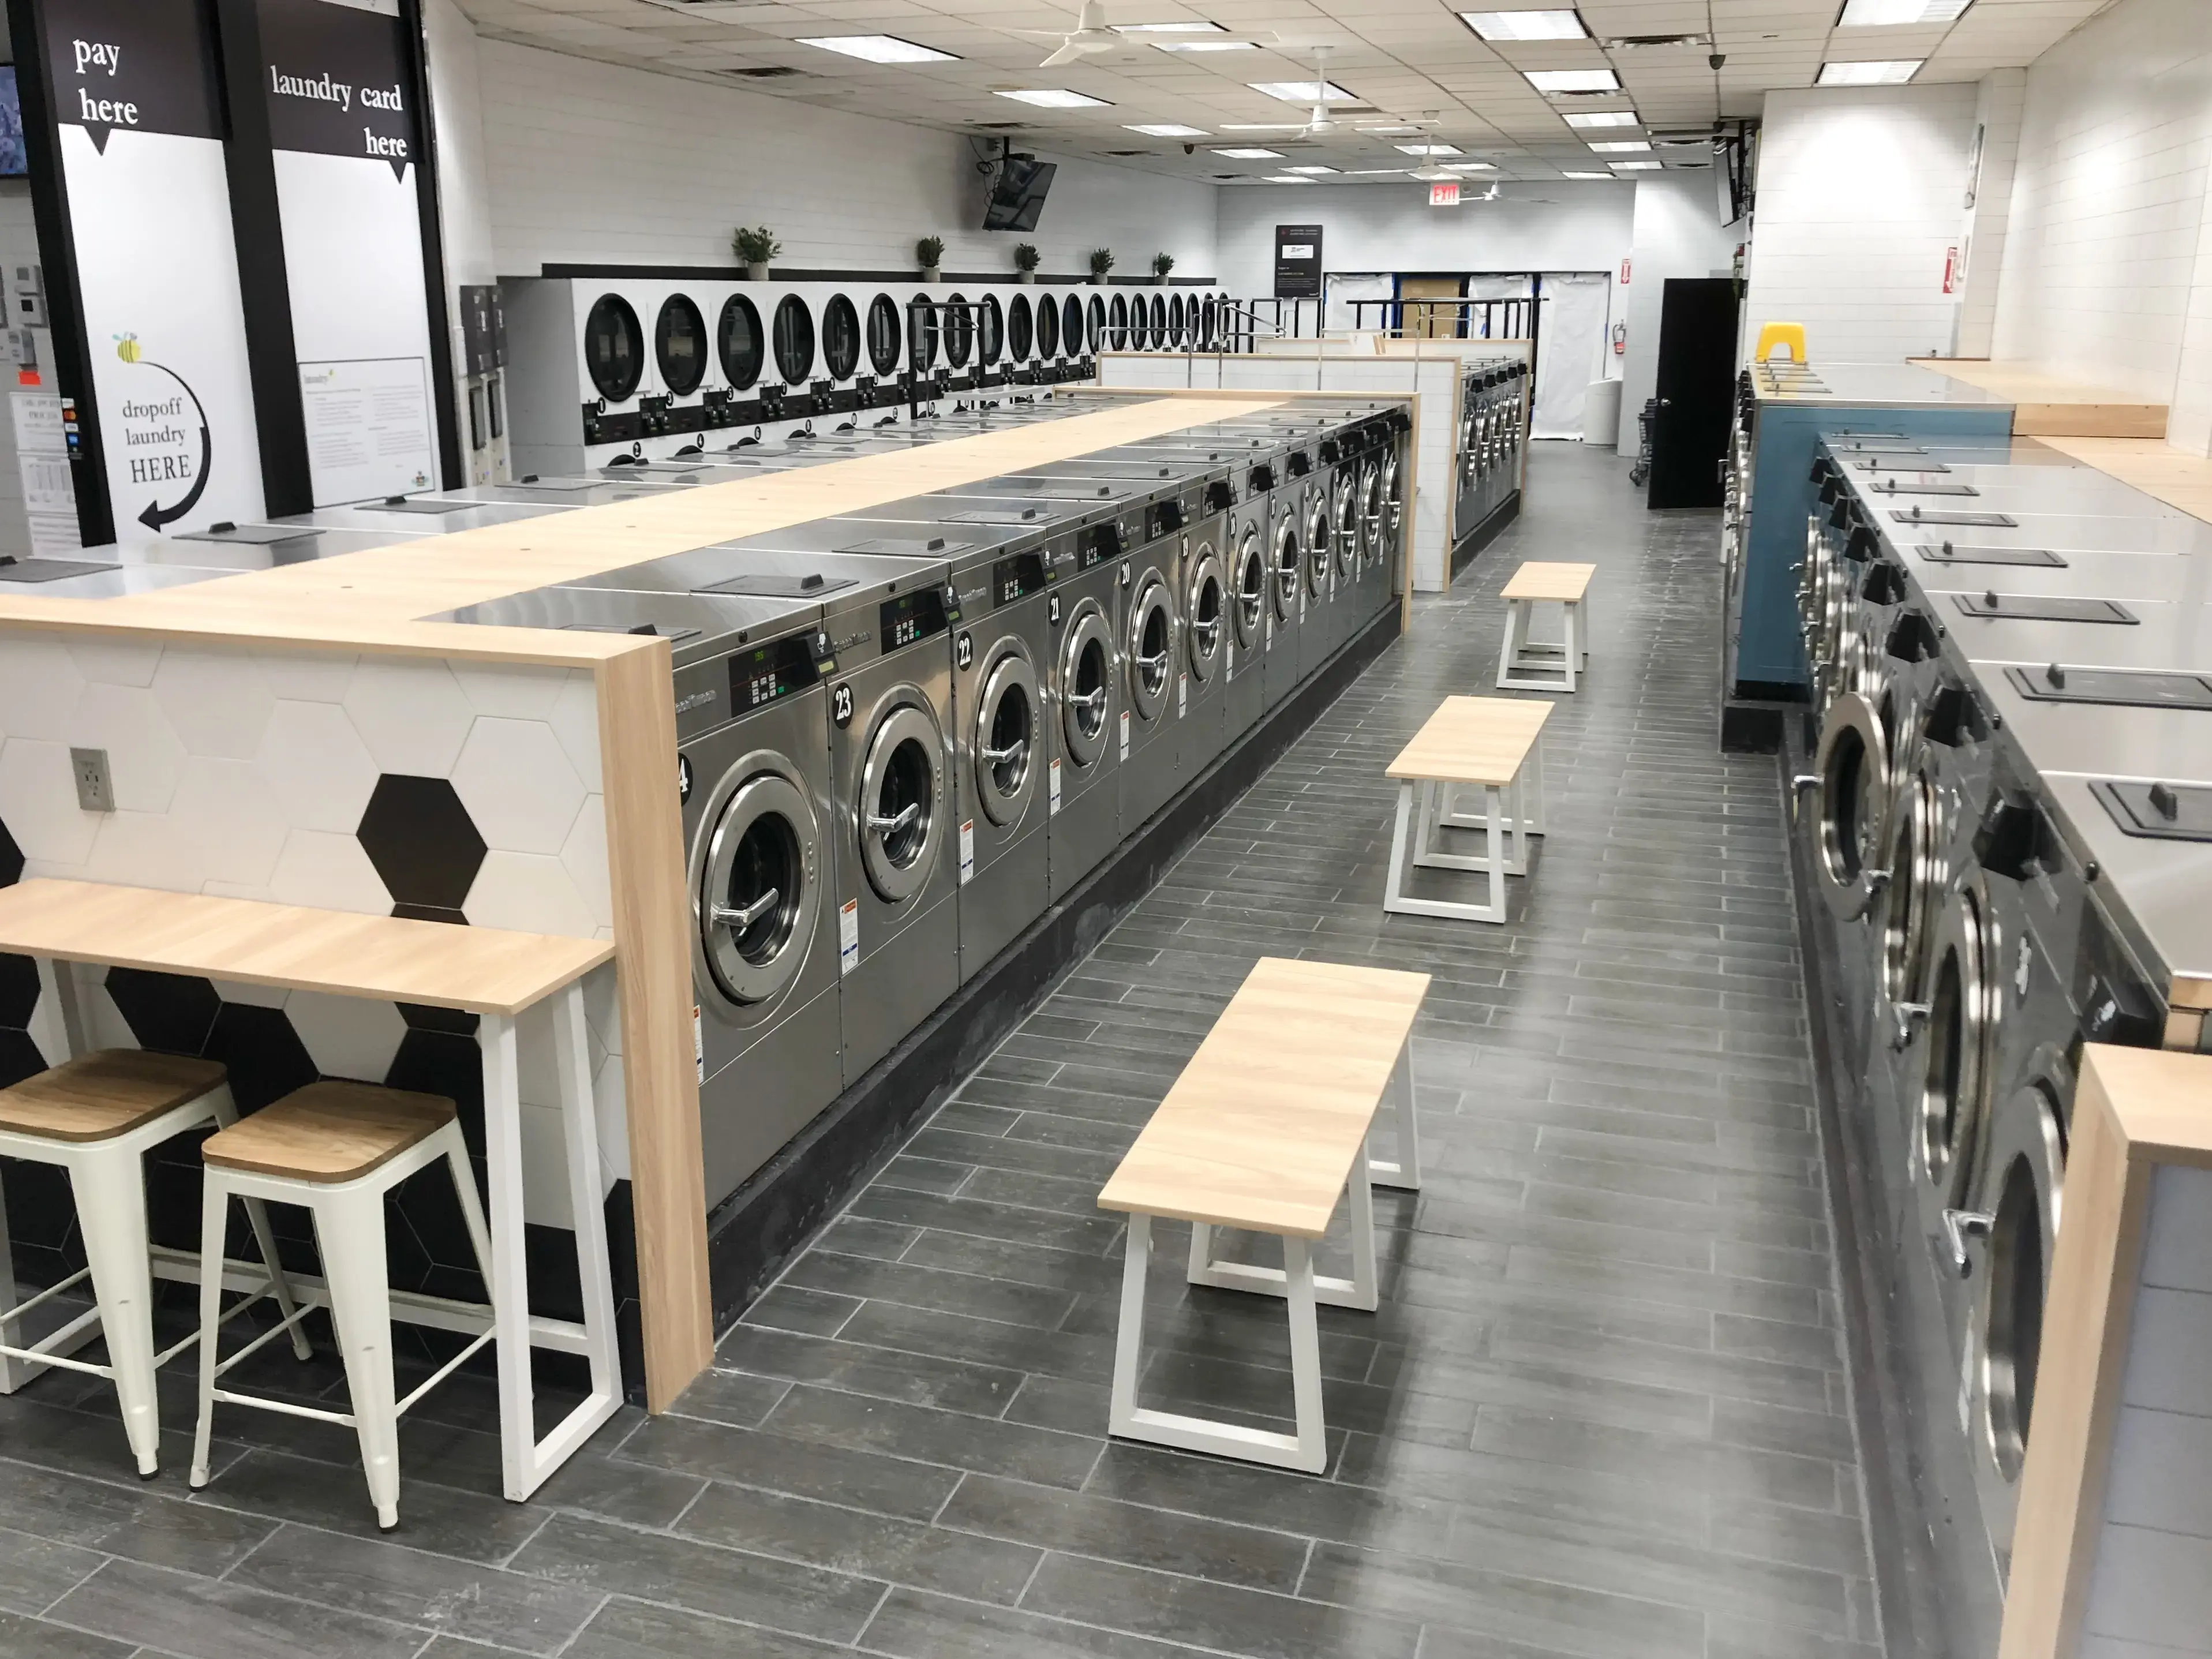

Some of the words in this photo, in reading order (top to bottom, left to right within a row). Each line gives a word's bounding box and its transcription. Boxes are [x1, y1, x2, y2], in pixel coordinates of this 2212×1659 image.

[73, 38, 120, 76] pay
[271, 65, 351, 111] laundry
[361, 85, 403, 111] card
[80, 88, 139, 124] here
[364, 127, 407, 157] here
[1434, 185, 1458, 203] EXIT
[122, 397, 182, 422] dropoff
[599, 400, 604, 412] 1
[125, 425, 185, 447] laundry
[130, 455, 192, 484] HERE
[1182, 536, 1189, 557] 19
[1121, 562, 1130, 585] 20
[1050, 596, 1060, 621] 21
[959, 636, 971, 666] 22
[835, 687, 853, 721] 23
[679, 757, 688, 793] 4
